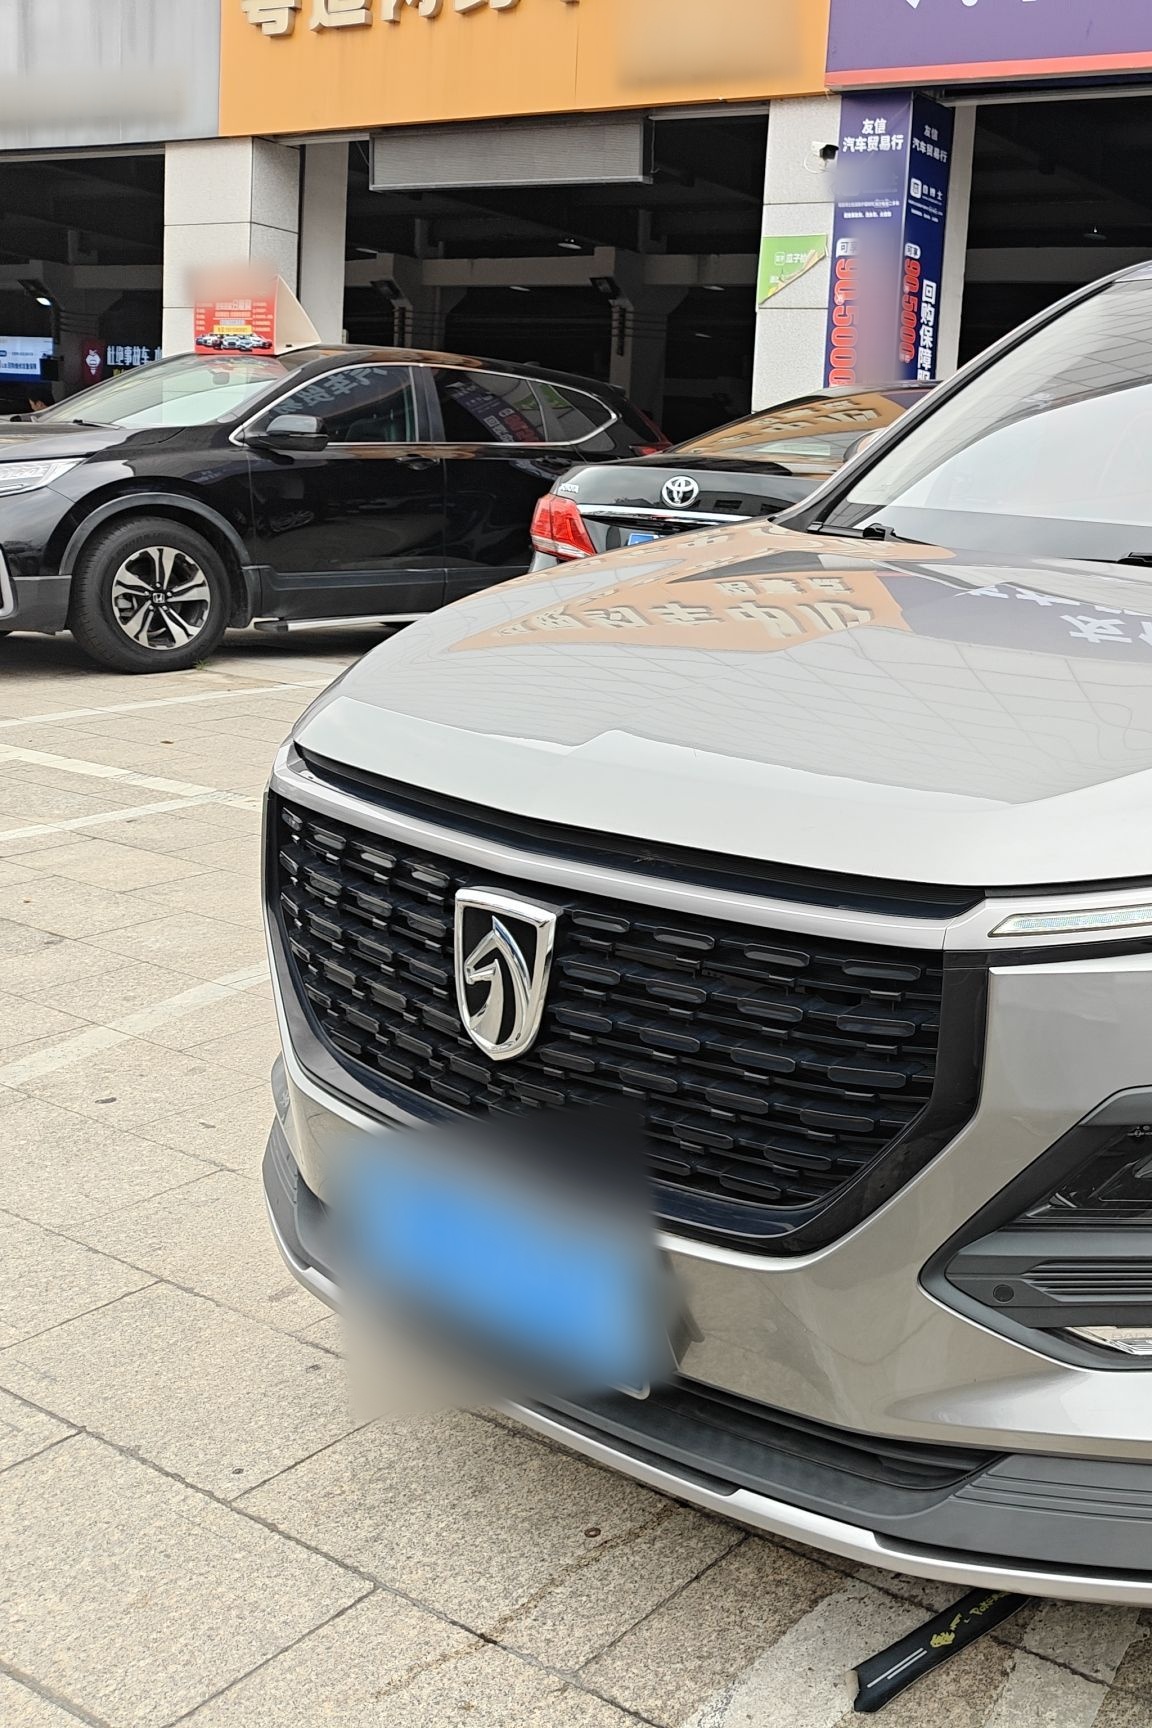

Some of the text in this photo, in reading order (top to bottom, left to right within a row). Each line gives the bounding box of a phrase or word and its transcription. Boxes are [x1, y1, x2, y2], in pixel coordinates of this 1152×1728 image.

[862, 117, 888, 135] 友信
[923, 124, 939, 142] 友信
[842, 134, 905, 153] 汽车贸易行
[912, 137, 949, 163] 汽车贸易行
